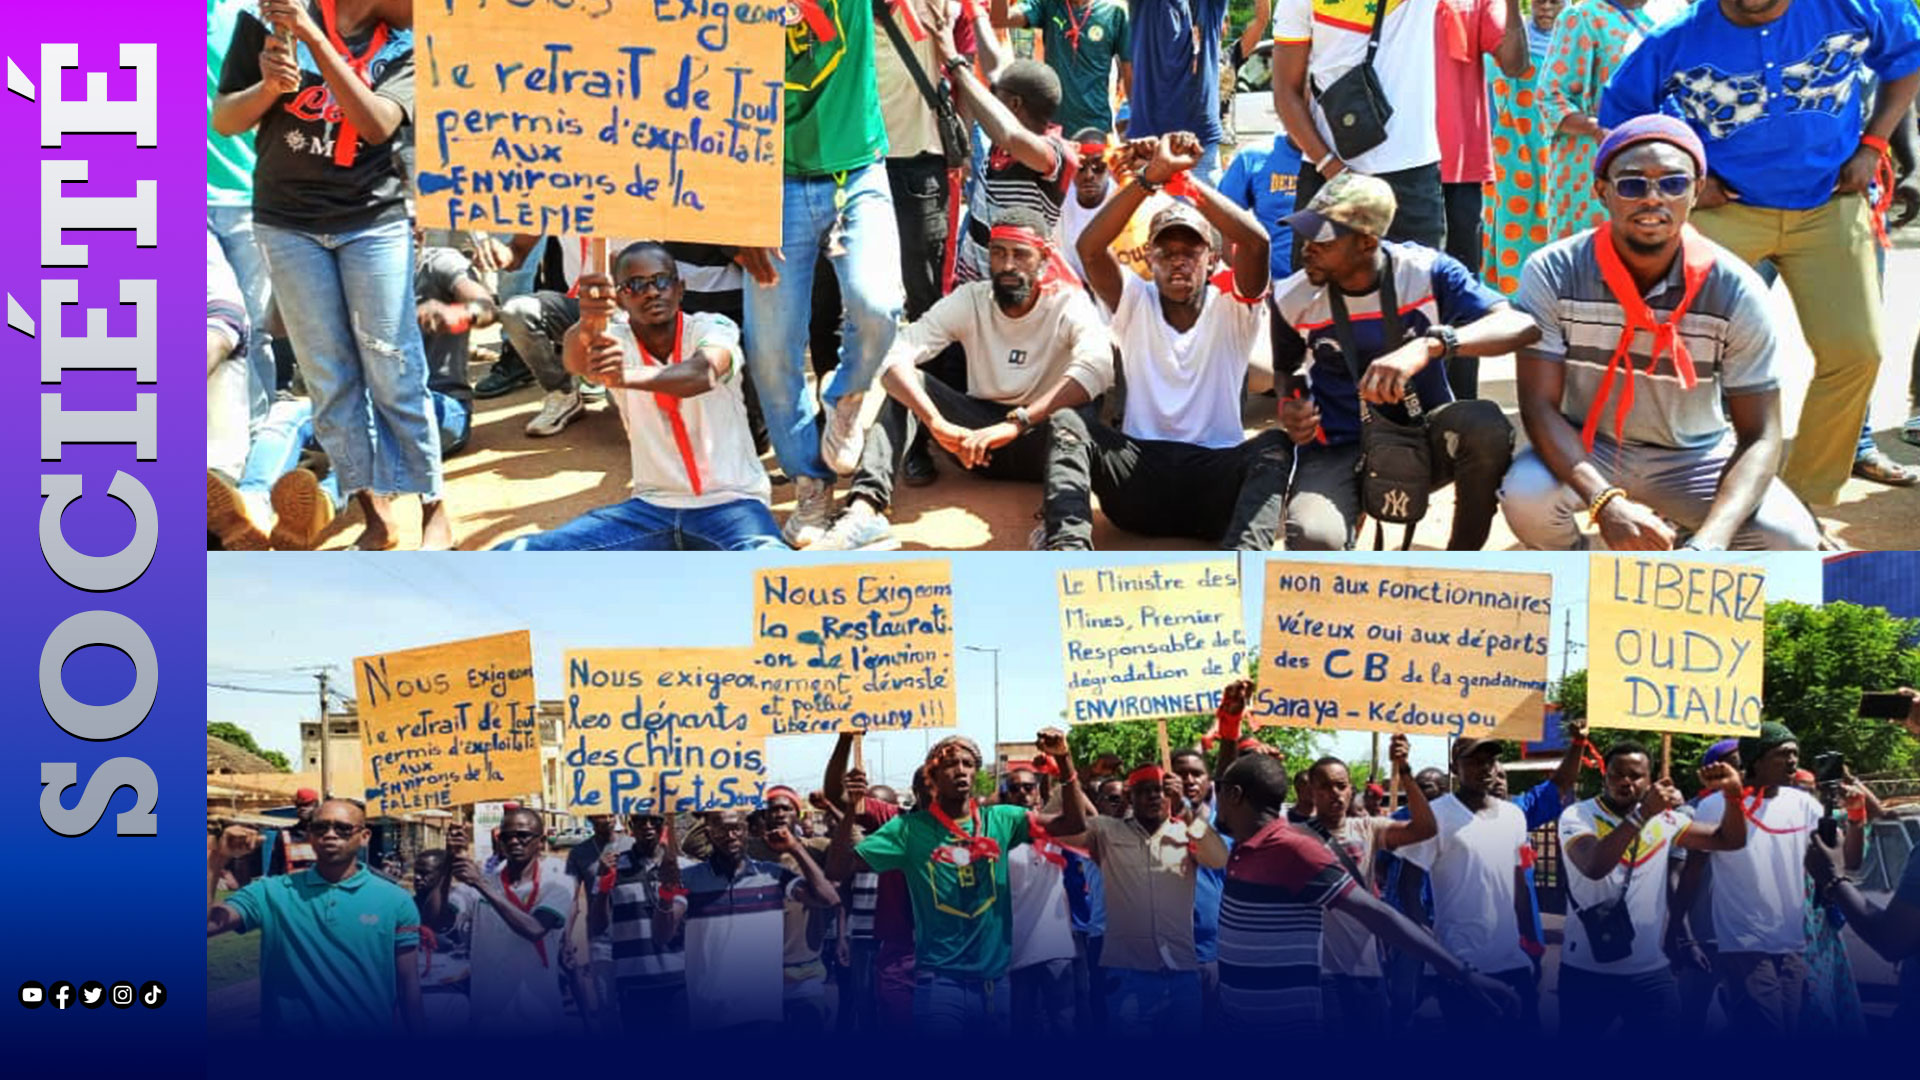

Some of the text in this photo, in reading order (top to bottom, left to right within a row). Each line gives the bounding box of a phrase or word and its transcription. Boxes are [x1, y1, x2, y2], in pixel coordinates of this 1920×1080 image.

[427, 36, 475, 88] le
[436, 109, 583, 168] permis
[625, 163, 660, 192] de
[672, 169, 705, 210] la
[763, 576, 847, 605] Nous
[1062, 566, 1238, 595] Le Ministre des
[1333, 575, 1370, 595] aux
[1615, 558, 1766, 621] LIBEREZ
[760, 612, 788, 638] la
[1141, 605, 1224, 627] Premier
[807, 643, 842, 669] de
[1068, 632, 1205, 669] Responsable
[1212, 630, 1231, 647] de
[1411, 627, 1450, 646] aux
[1457, 628, 1548, 656] départs
[364, 656, 450, 708] Nous
[570, 658, 643, 688] Nous
[1069, 659, 1189, 695] dégradation
[1201, 657, 1224, 676] de
[1274, 650, 1310, 668] des
[1400, 660, 1424, 683] de
[1431, 662, 1451, 685] la
[761, 694, 784, 715] et
[1075, 689, 1222, 722] ENVIRONNEME
[1253, 688, 1338, 726] Saraya
[1624, 676, 1763, 731] DIALLO
[364, 719, 388, 746] le
[568, 694, 748, 756] les départs
[372, 742, 441, 785] permis
[566, 735, 619, 767] des
[569, 769, 600, 806] le
